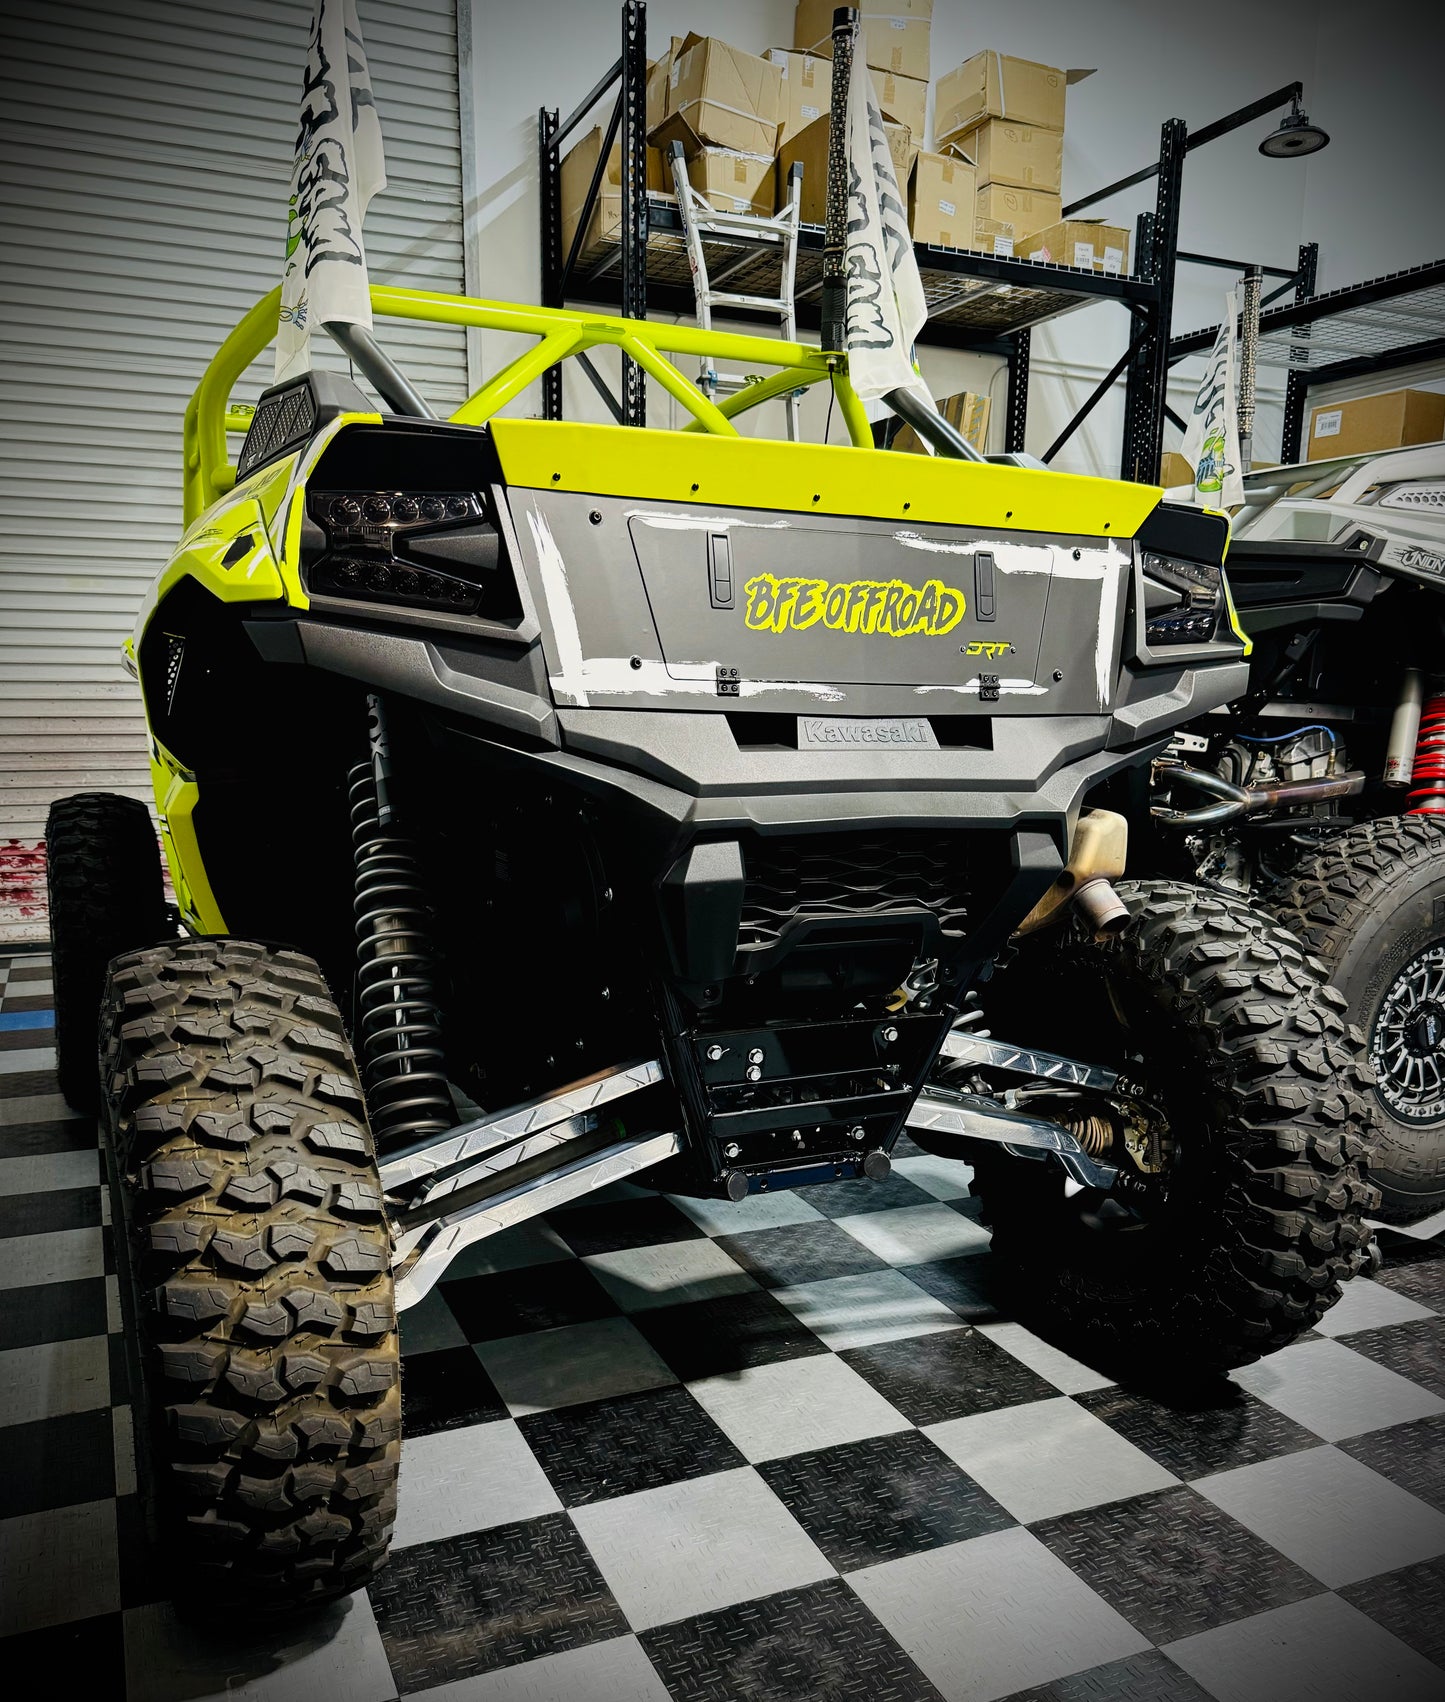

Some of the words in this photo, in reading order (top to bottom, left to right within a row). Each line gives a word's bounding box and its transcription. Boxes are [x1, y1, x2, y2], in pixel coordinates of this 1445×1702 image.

[746, 575, 826, 632] BFE
[824, 580, 965, 636] OFFROAD
[804, 720, 929, 743] Kawasaki
